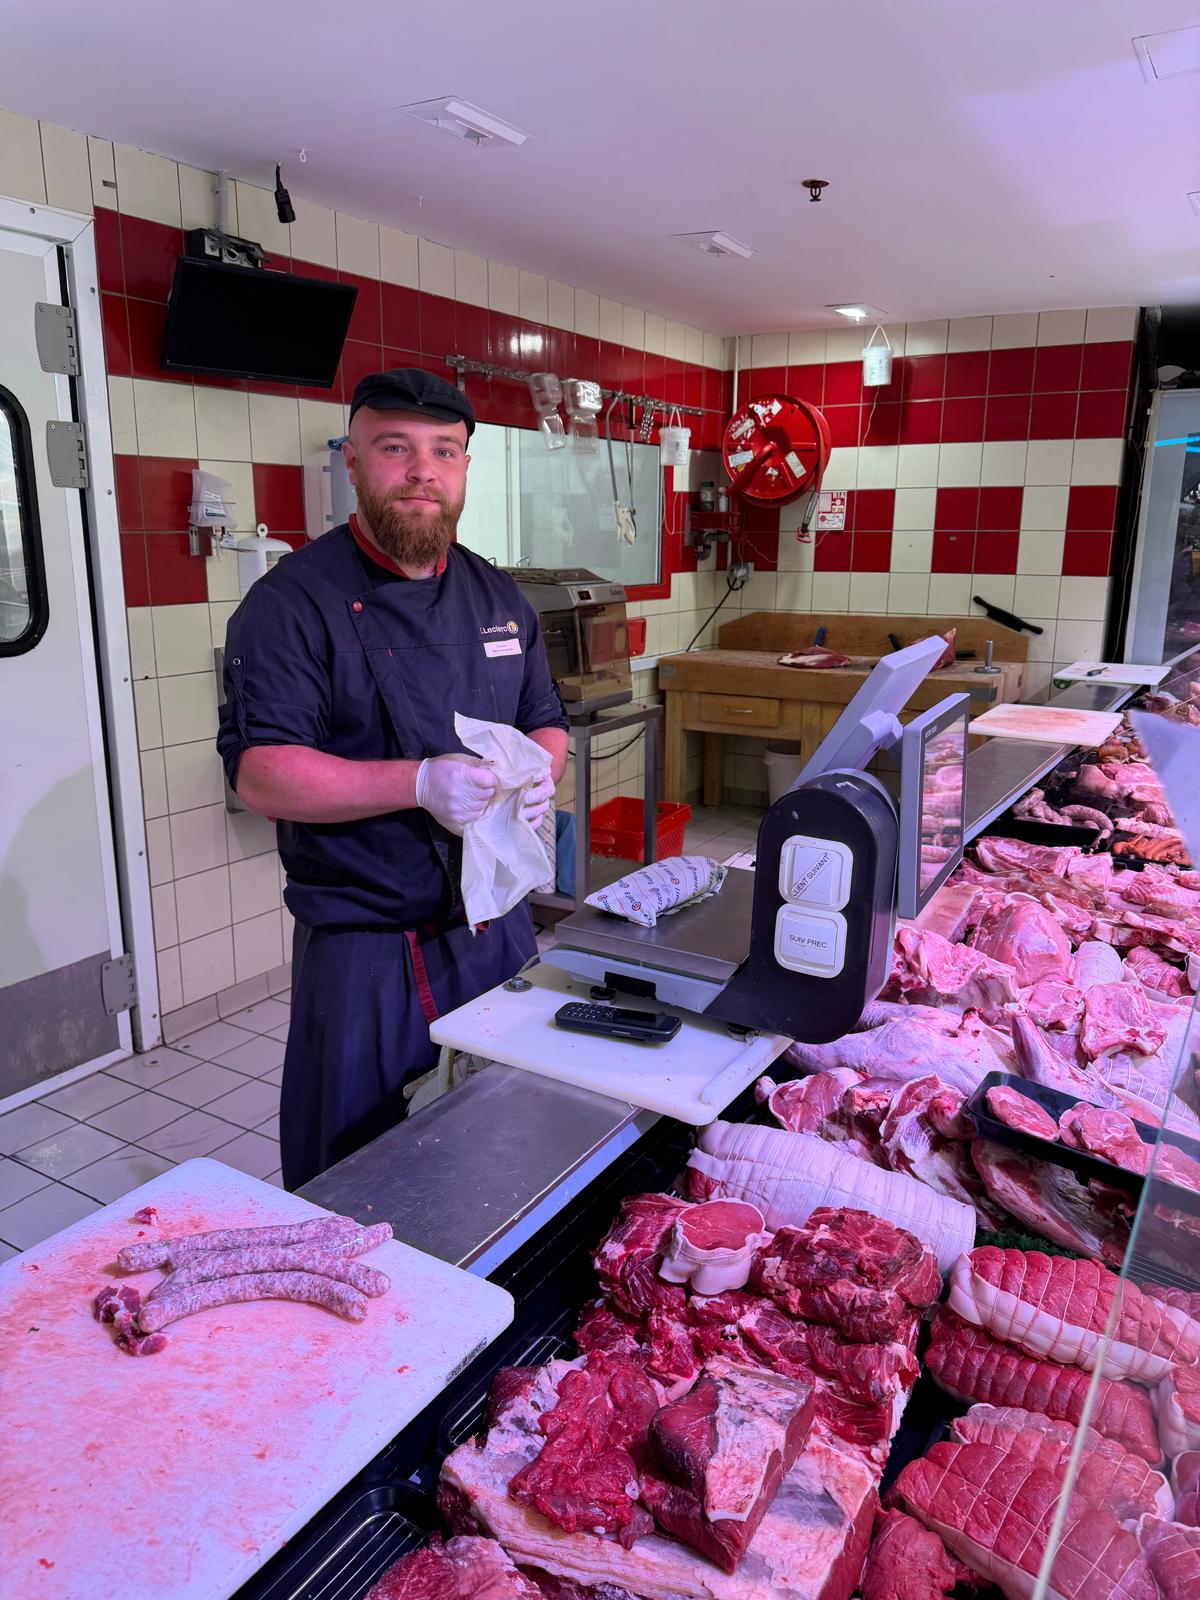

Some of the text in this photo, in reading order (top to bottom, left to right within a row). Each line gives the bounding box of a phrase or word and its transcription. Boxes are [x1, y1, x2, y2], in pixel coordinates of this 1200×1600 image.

[792, 852, 831, 898] CLIENT SUIVANT
[789, 934, 828, 949] SUIV PREC
